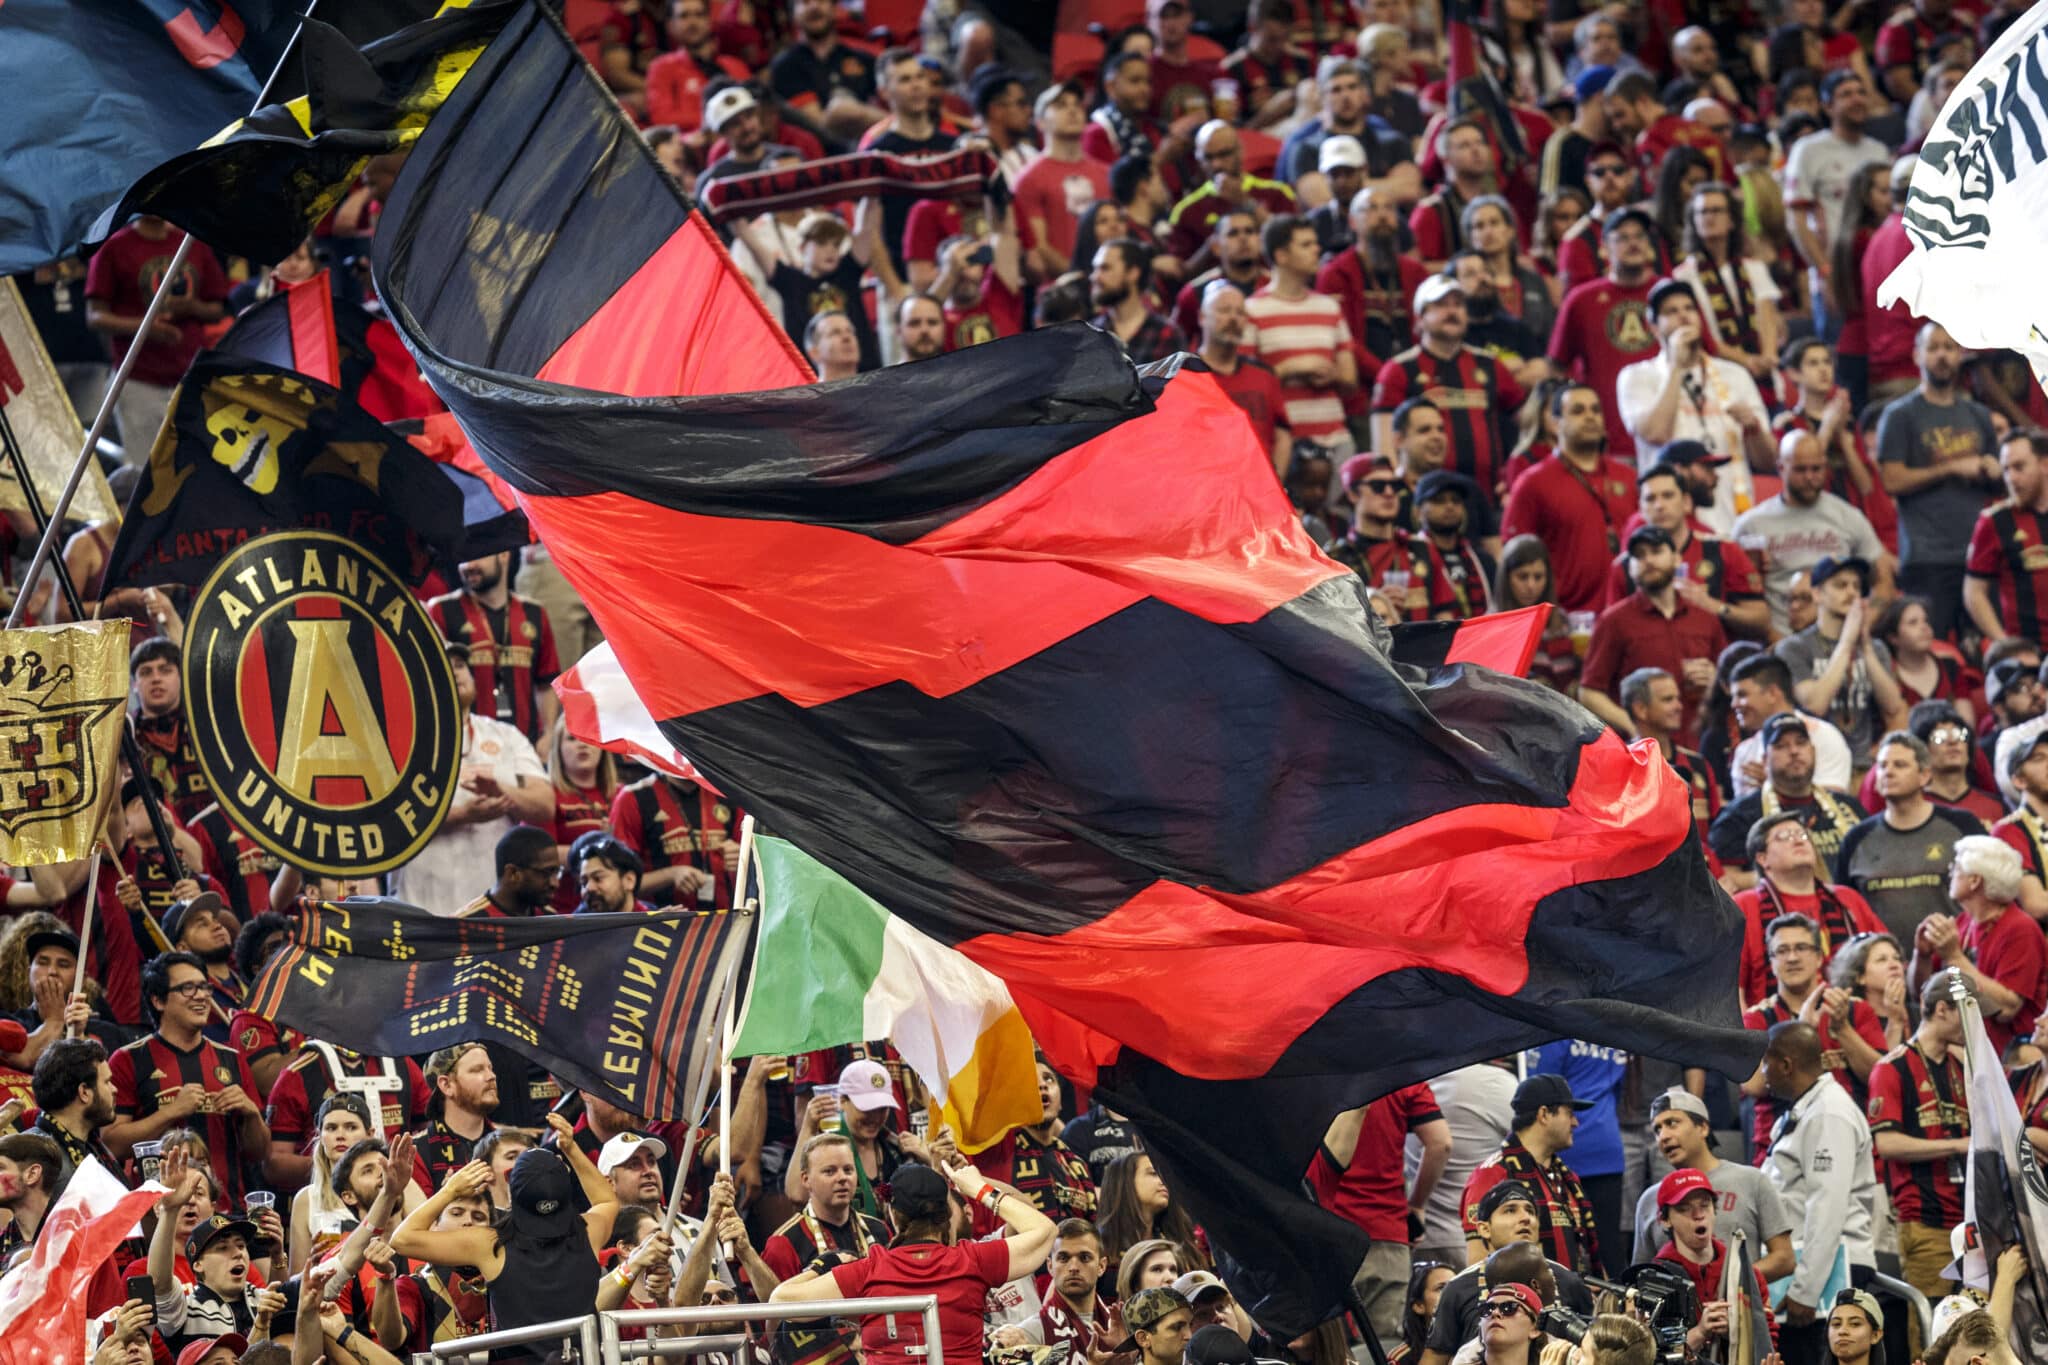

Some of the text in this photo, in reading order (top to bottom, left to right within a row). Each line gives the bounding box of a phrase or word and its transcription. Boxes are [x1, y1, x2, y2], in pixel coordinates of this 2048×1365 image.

[218, 549, 407, 635] ATLANTA
[275, 620, 400, 801] A
[238, 770, 440, 860] UNITED FC
